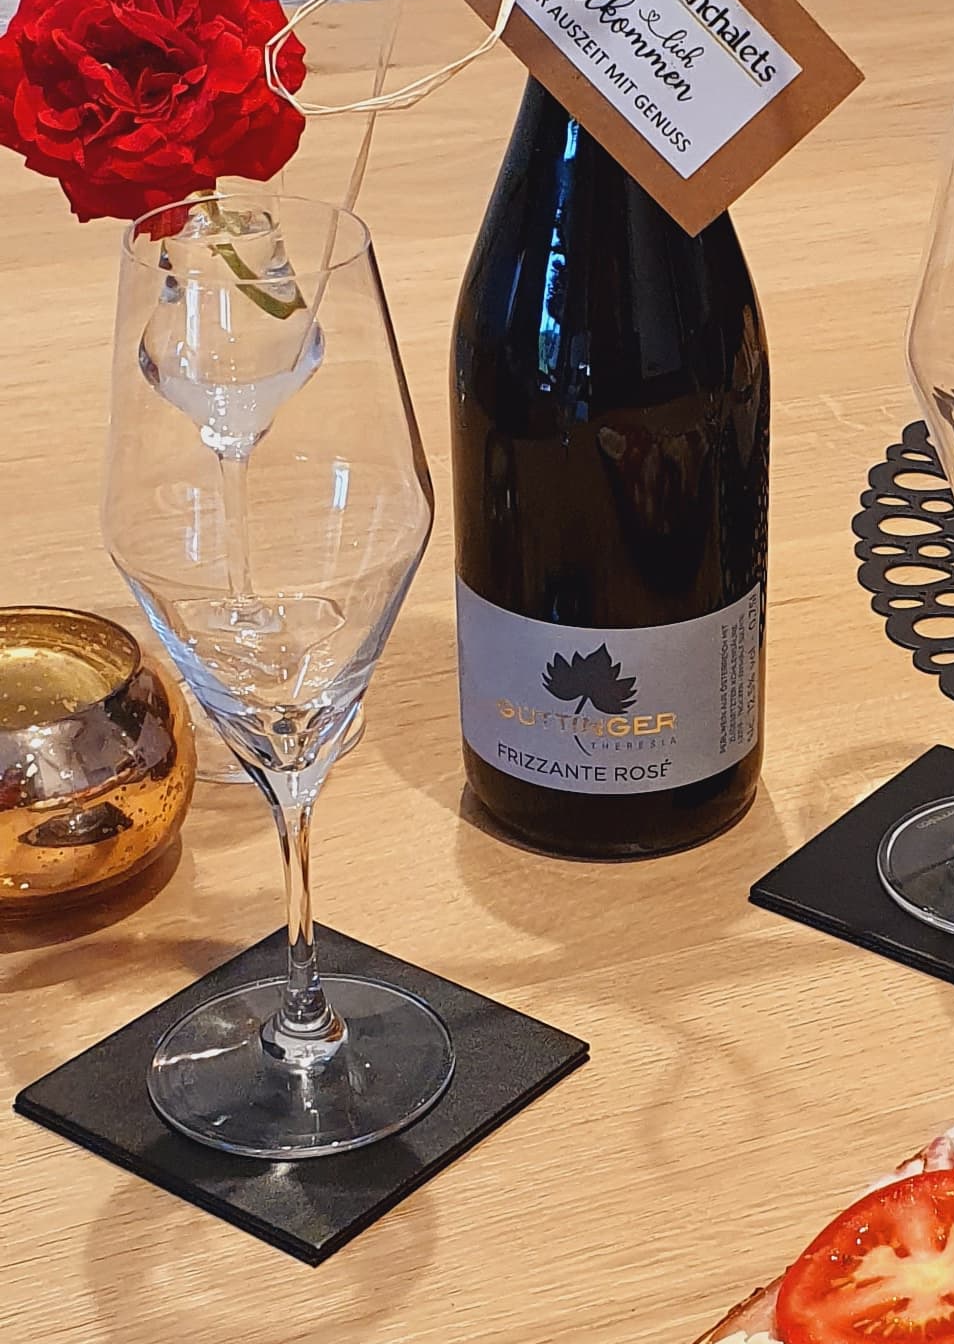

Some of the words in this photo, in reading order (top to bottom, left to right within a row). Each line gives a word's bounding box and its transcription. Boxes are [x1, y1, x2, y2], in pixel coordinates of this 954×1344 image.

[661, 29, 705, 70] lich
[547, 4, 609, 67] AUSZEIT
[604, 63, 638, 97] MIT
[633, 94, 692, 154] GENUSS
[497, 742, 607, 782] FRIZZANTE
[614, 758, 673, 782] ROSÉ
[590, 736, 678, 752] THERESIA
